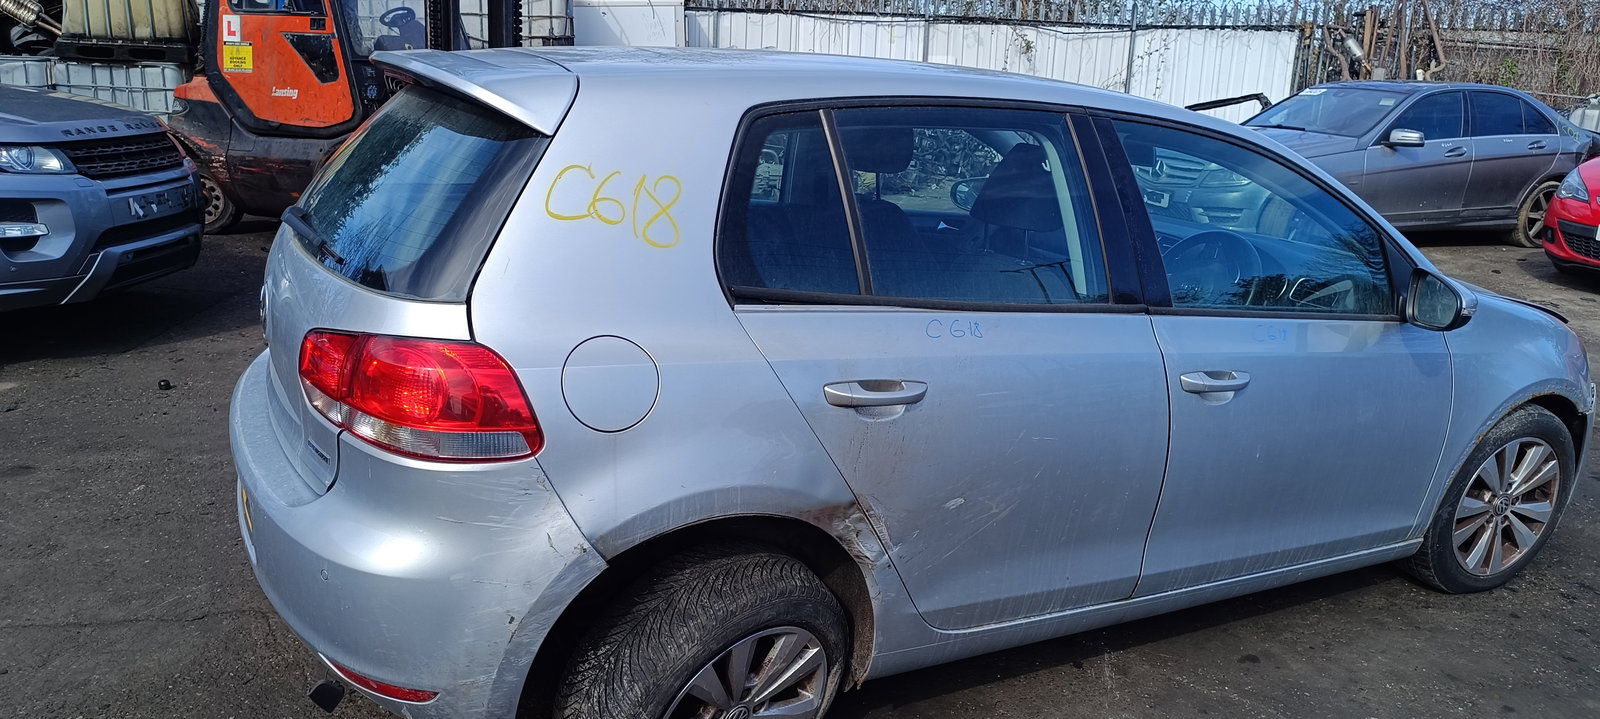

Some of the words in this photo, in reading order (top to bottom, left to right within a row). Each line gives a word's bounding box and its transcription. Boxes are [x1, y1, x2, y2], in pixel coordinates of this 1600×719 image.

[227, 21, 236, 36] L
[271, 86, 299, 99] Lansing
[61, 125, 119, 137] RANGE
[545, 163, 681, 249] C618
